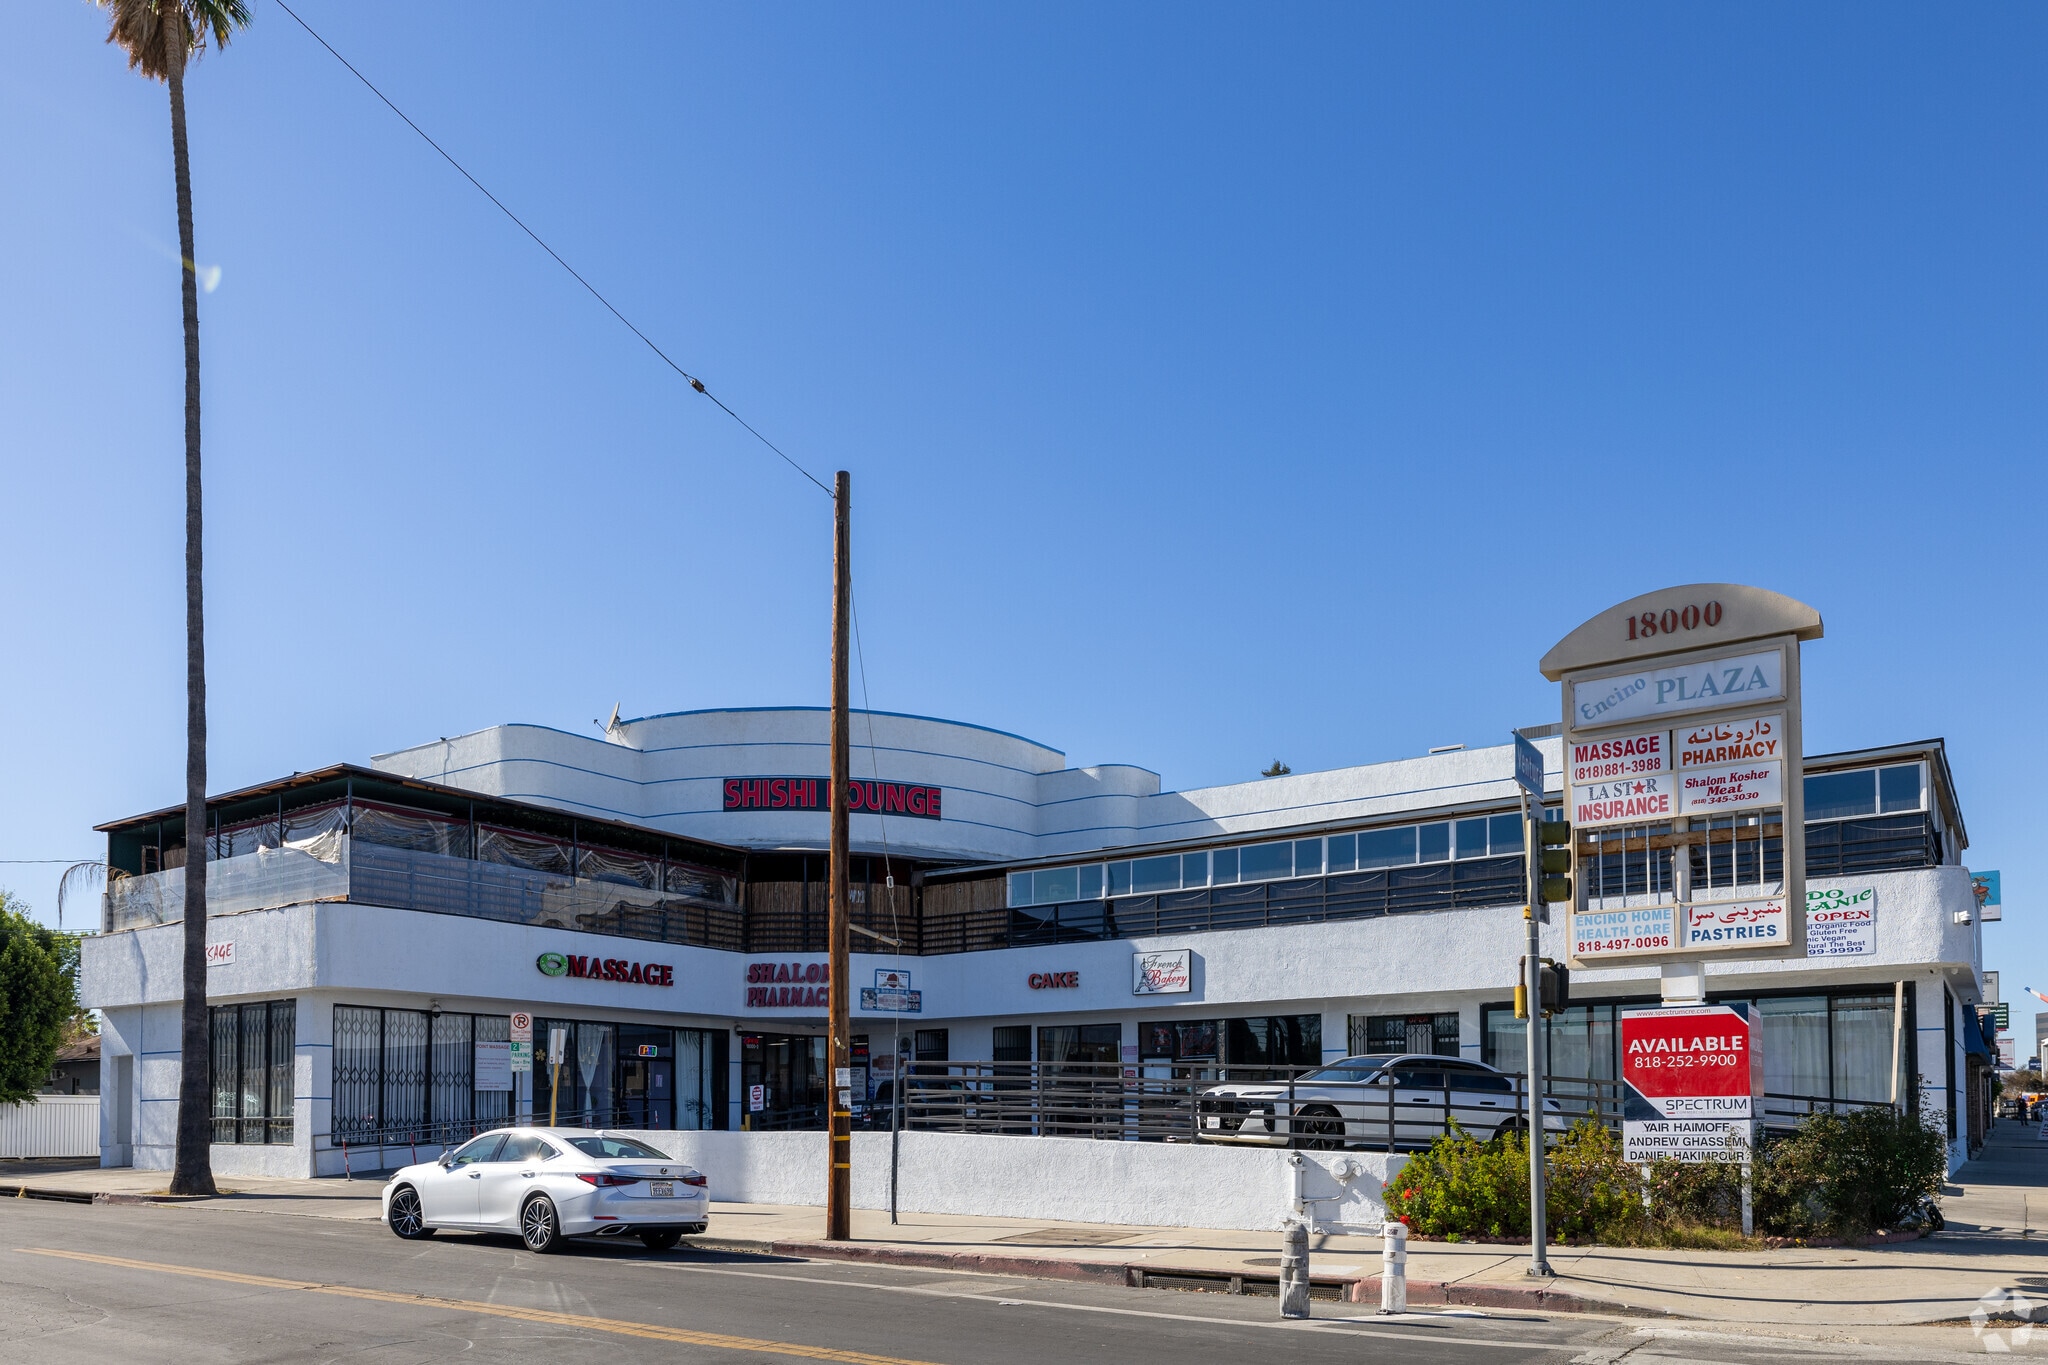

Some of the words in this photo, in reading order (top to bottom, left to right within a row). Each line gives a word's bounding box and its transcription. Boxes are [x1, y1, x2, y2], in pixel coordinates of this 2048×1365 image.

[1625, 600, 1723, 642] 18000
[1580, 678, 1646, 720] Encino
[1655, 665, 1770, 705] PLAZA
[1687, 720, 1771, 744] داروخانه
[1575, 736, 1660, 763] MASSAGE
[1682, 740, 1777, 766] PHARMACY
[1517, 744, 1543, 788] Ventura
[1575, 757, 1661, 780] (818)881-3988
[1685, 775, 1726, 789] Shalom
[1729, 770, 1770, 783] Kosher
[725, 780, 817, 808] SHISHI
[1588, 785, 1610, 801] LA
[1691, 798, 1707, 806] (818)
[1708, 792, 1759, 804] 345-3030
[1706, 783, 1743, 797] Meat
[1578, 794, 1669, 822] INSURANCE
[1576, 912, 1627, 926] ENCINO
[1631, 909, 1671, 922] HOME
[1814, 910, 1870, 922] OPEN
[1577, 926, 1629, 940] HEALTH
[1634, 923, 1670, 936] CARE
[1691, 924, 1777, 942] PASTRIES
[1821, 935, 1846, 943] Vegan
[205, 943, 234, 962] SAGE
[1578, 936, 1669, 952] 818-497-0096
[566, 954, 674, 987] MASSAGE
[1141, 955, 1184, 970] French
[1028, 971, 1079, 989] CAKE
[1146, 966, 1188, 989] Bakery
[747, 987, 830, 1007] PHARMAC
[1636, 1008, 1711, 1017] www.spectrumcre.com
[1628, 1036, 1743, 1053] AVAILABLE
[1635, 1055, 1737, 1068] 818-252-9900
[1666, 1098, 1747, 1110] SPECTRUM
[1643, 1122, 1669, 1132] YAIR
[1674, 1122, 1729, 1132] HAIMOFF
[1629, 1137, 1679, 1146] ANDREW
